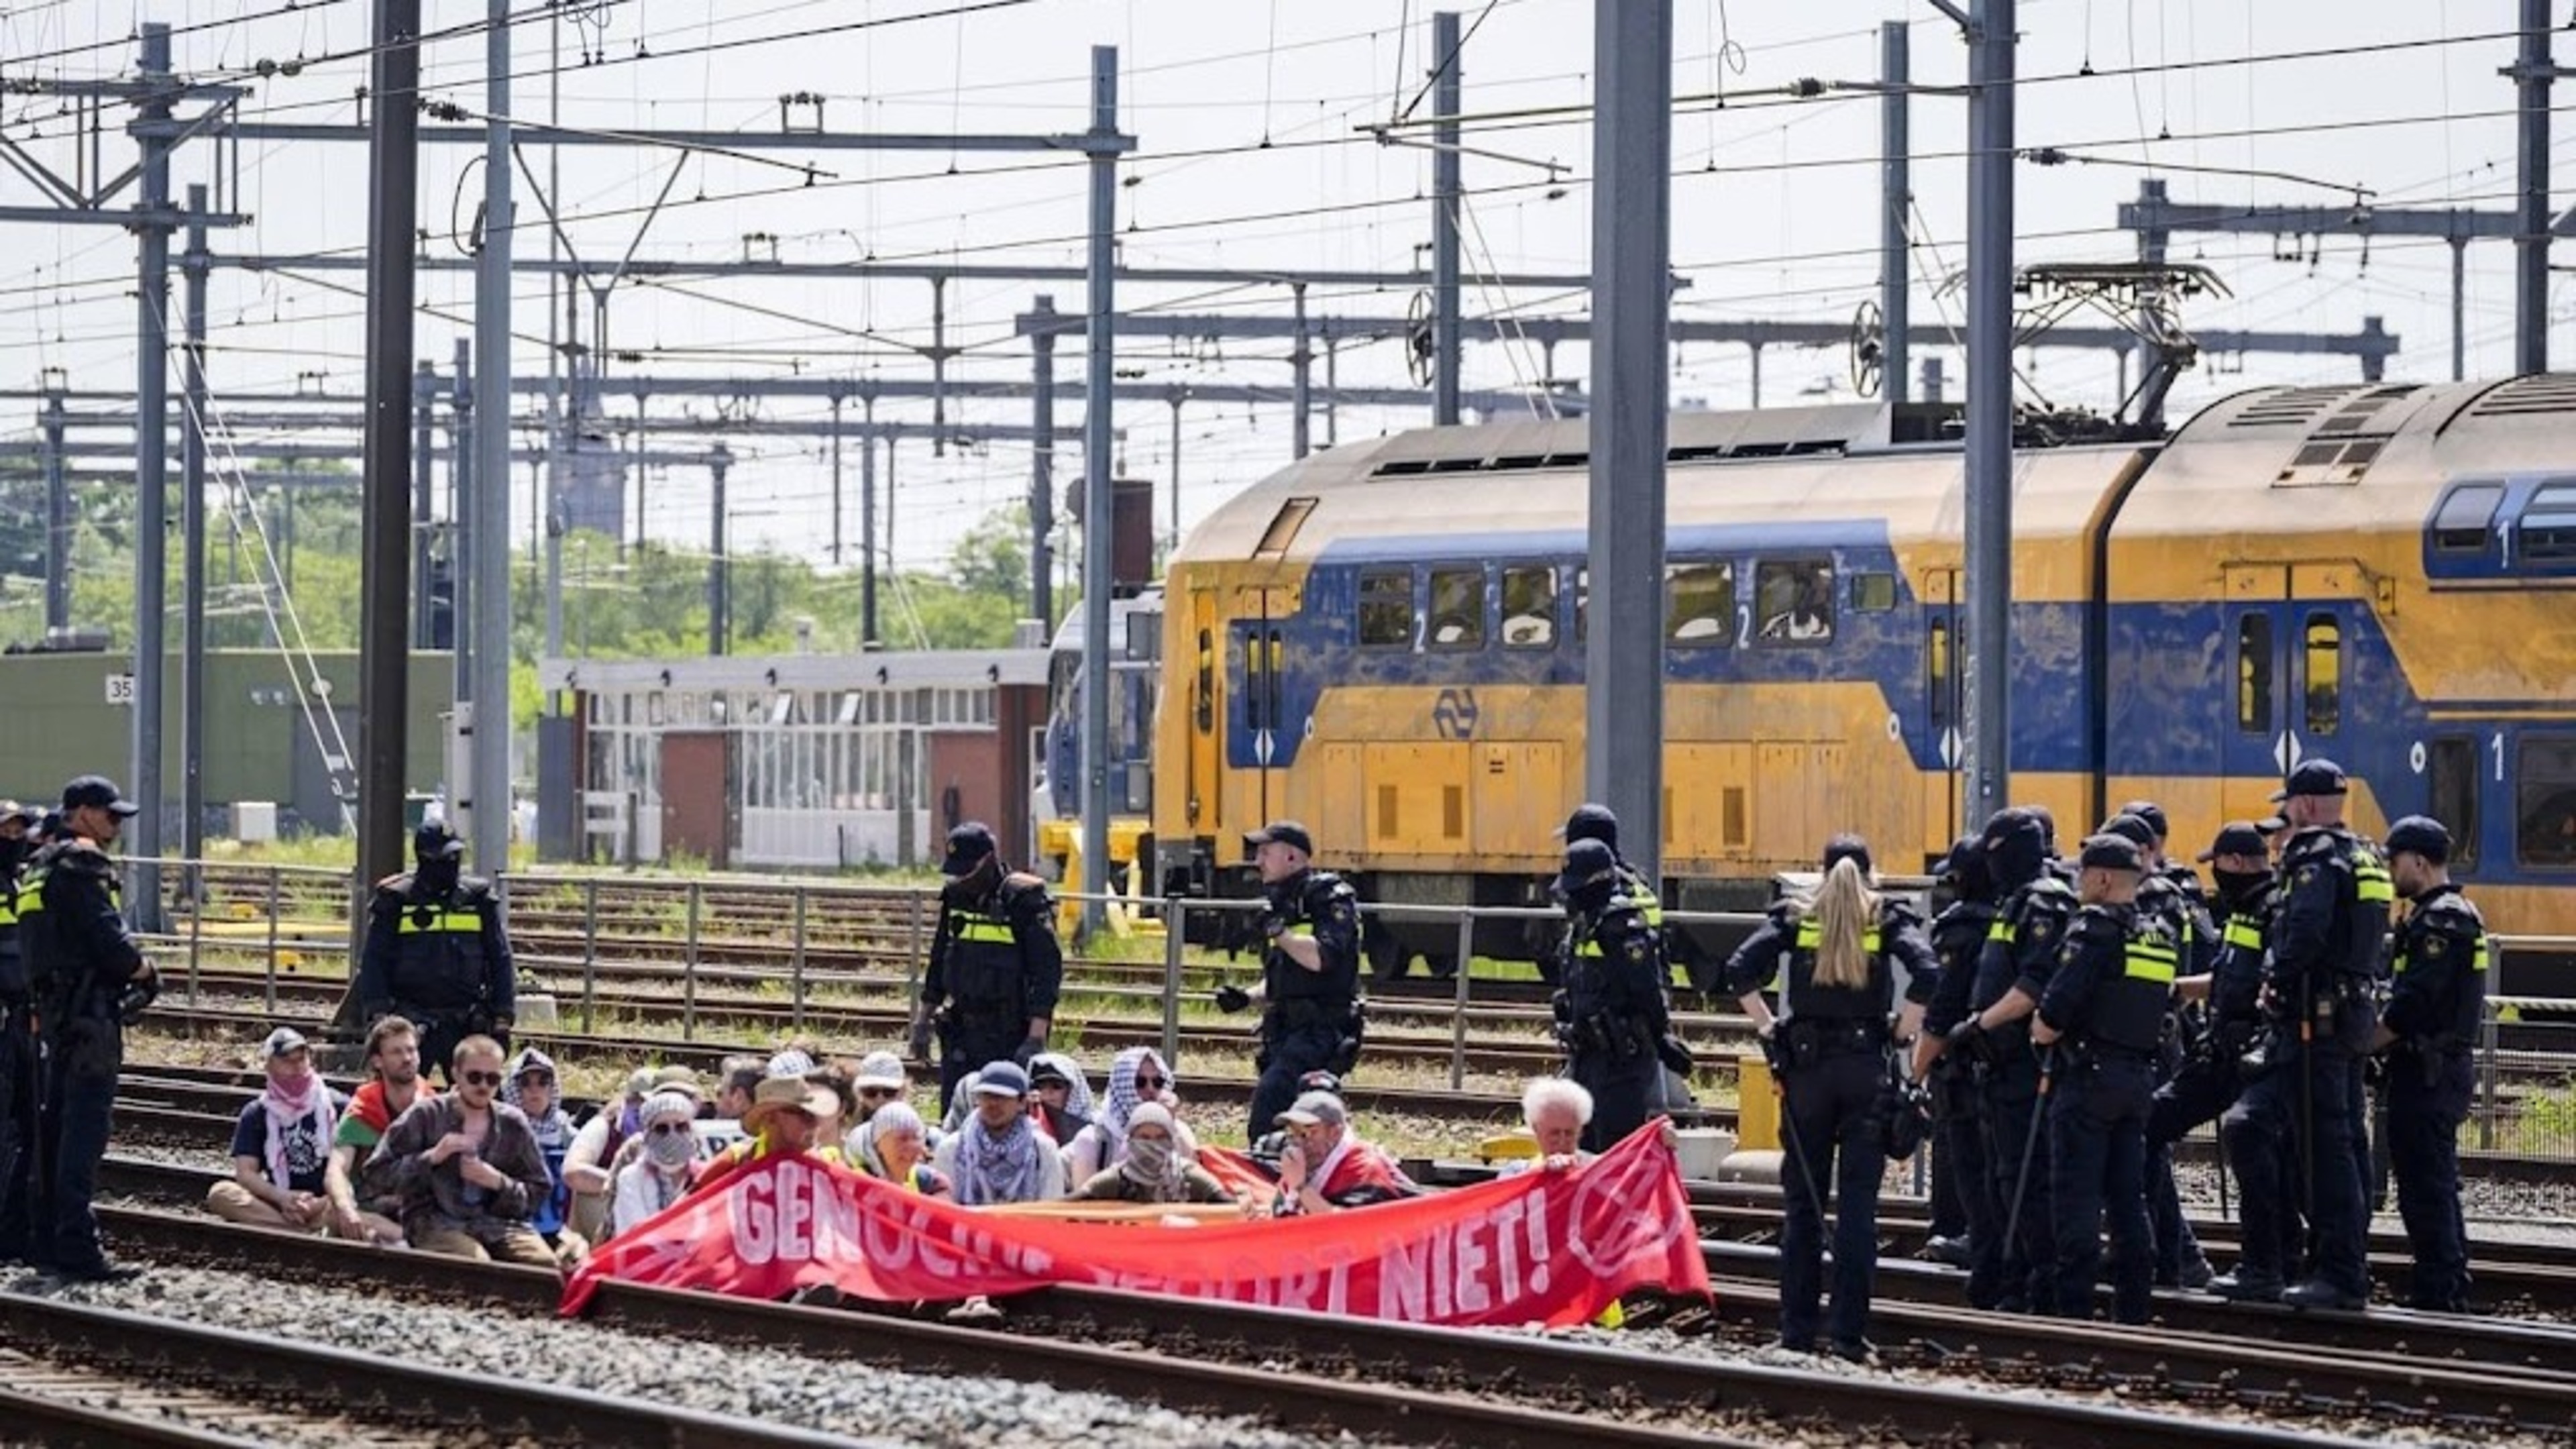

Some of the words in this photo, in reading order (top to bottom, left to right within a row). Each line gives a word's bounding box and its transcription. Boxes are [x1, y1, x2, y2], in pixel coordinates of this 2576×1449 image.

[2497, 520, 2509, 570] 1
[1414, 612, 1425, 653] 2
[1737, 604, 1750, 649] 2
[111, 681, 131, 697] 35
[2491, 733, 2504, 781] 1
[1379, 1186, 1550, 1322] NIET!
